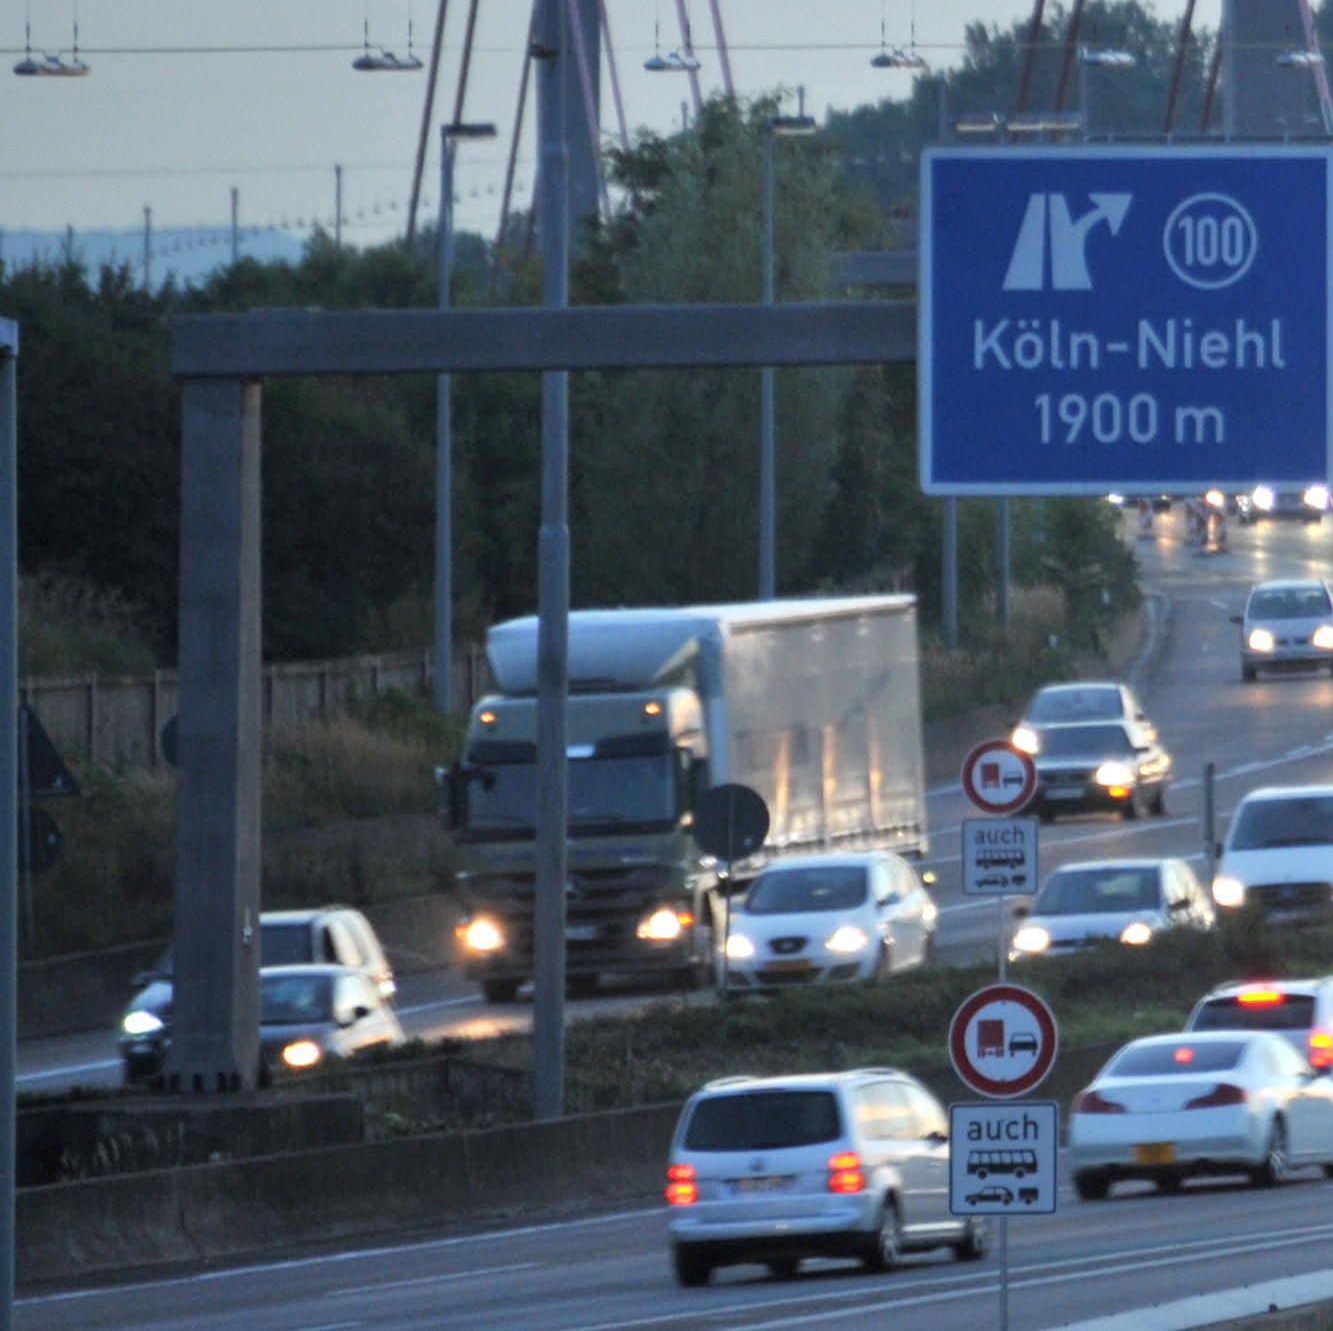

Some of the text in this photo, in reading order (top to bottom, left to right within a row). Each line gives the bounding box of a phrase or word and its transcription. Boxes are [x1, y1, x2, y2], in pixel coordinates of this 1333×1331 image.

[1178, 215, 1245, 267] 100
[973, 318, 1286, 370] Köln-Niehl
[1034, 393, 1225, 444] 1900 m
[974, 825, 1025, 846] auch
[967, 1112, 1038, 1141] auch
